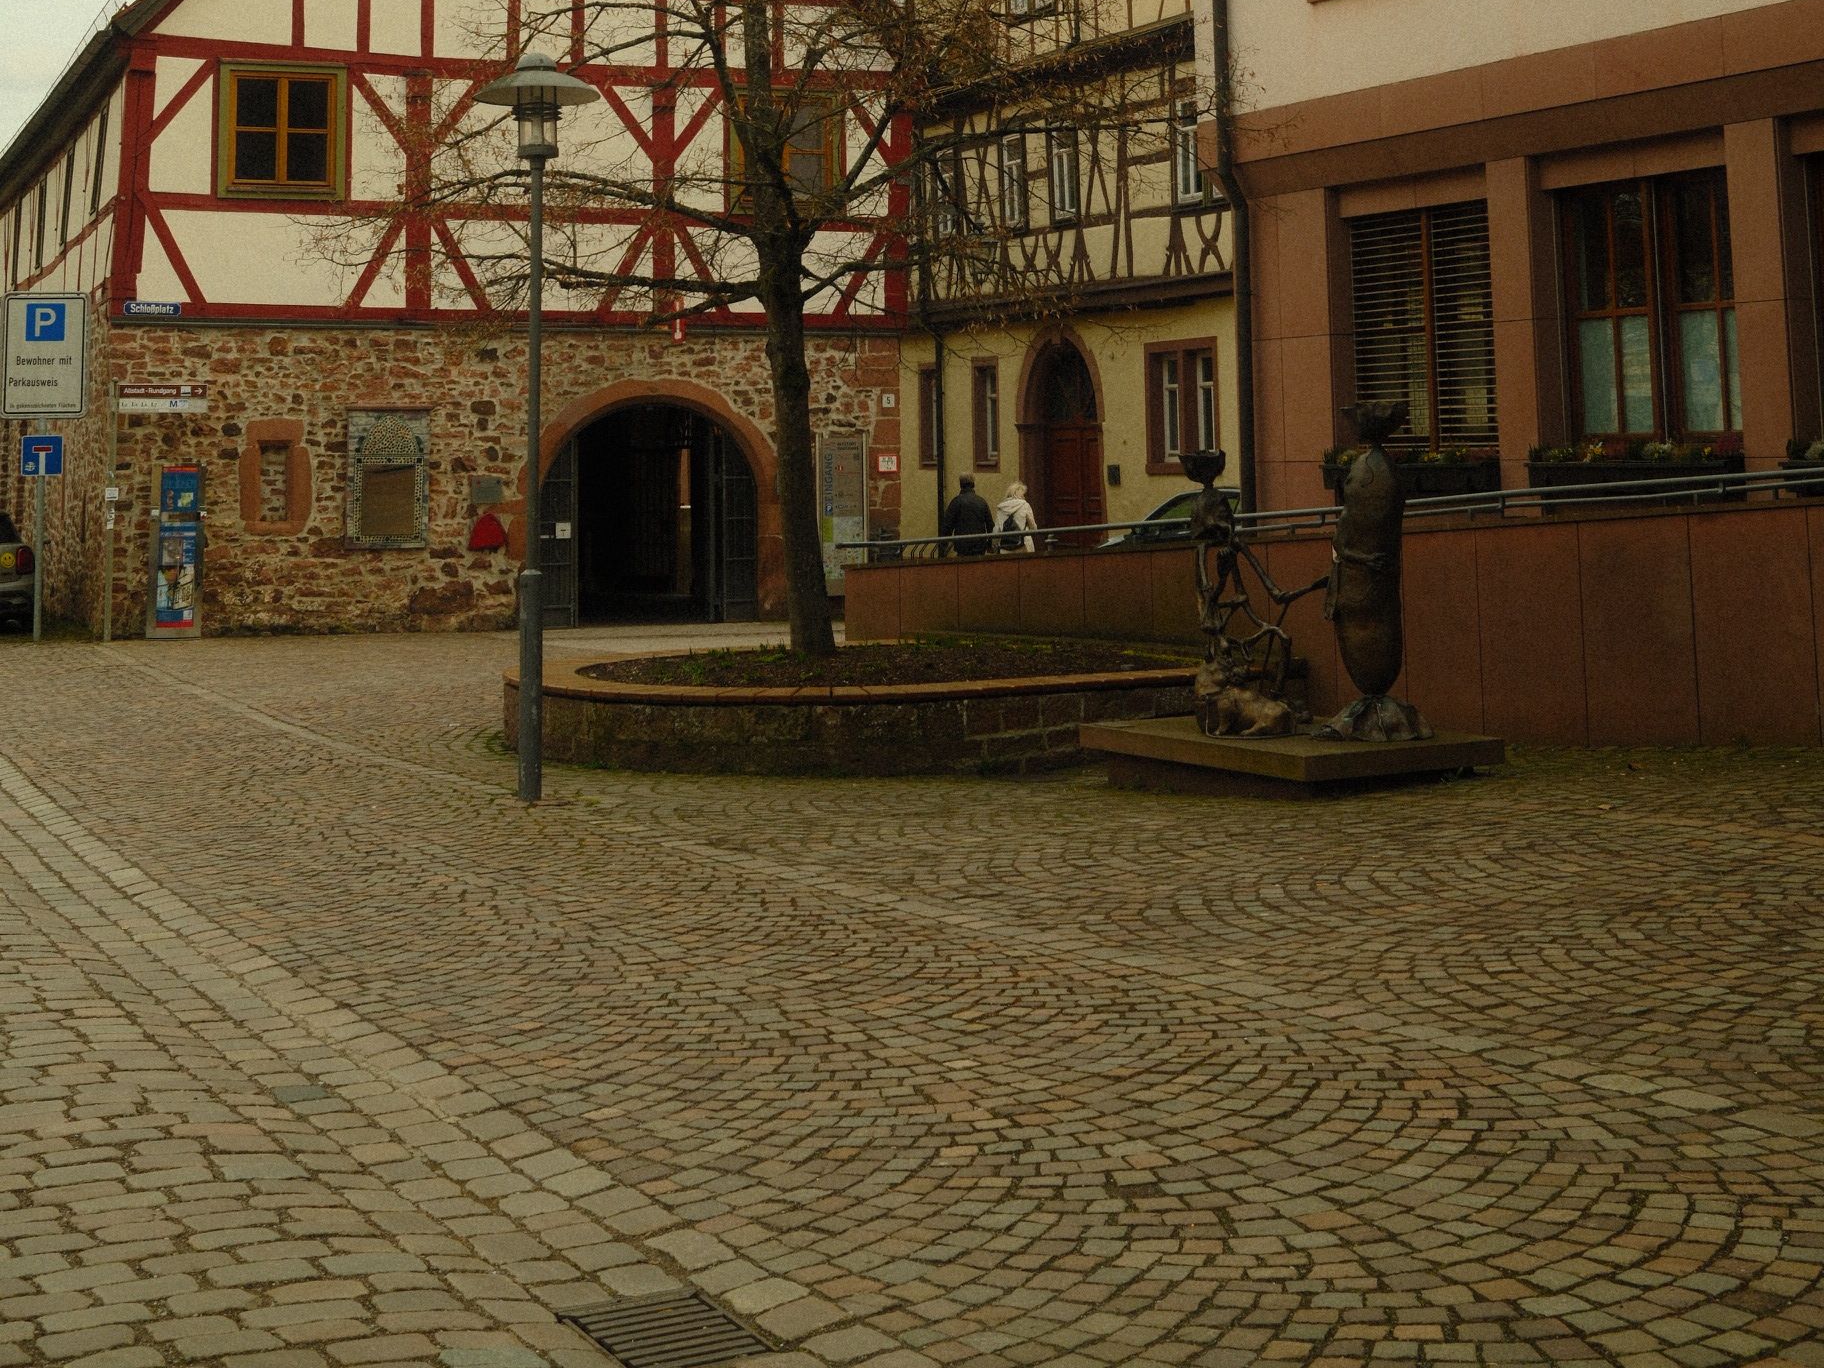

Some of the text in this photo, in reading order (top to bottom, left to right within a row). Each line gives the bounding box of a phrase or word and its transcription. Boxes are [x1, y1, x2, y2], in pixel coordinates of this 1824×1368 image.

[130, 303, 174, 315] Schloßplatz
[34, 308, 56, 337] P
[16, 355, 72, 365] Bewohner mit
[8, 377, 58, 387] Parkausweis
